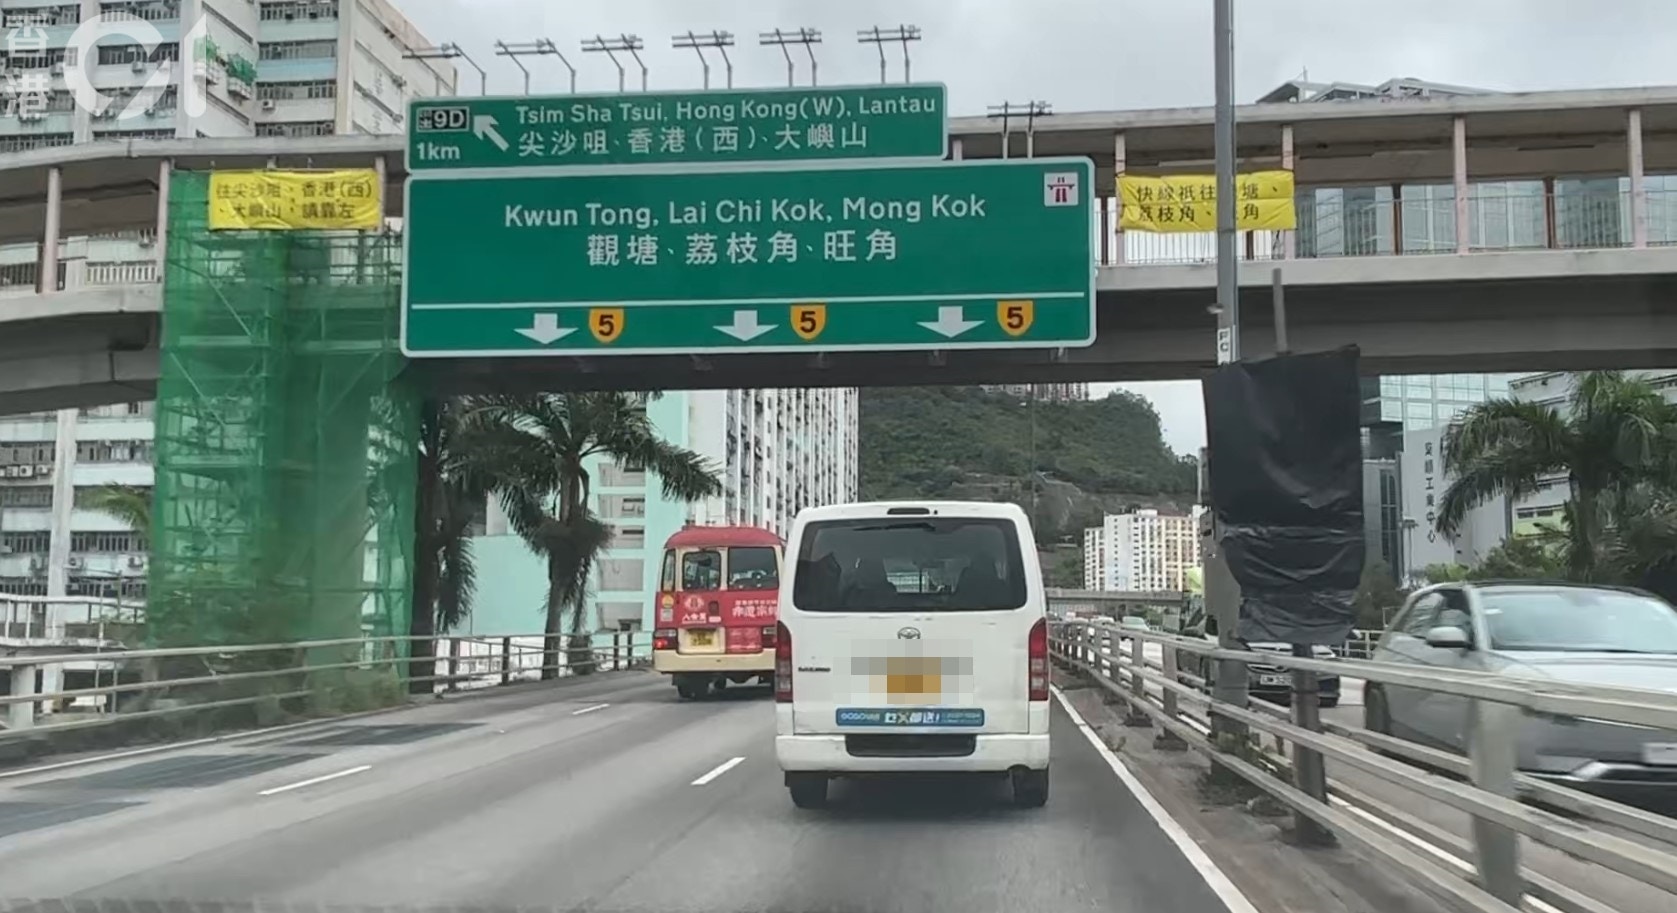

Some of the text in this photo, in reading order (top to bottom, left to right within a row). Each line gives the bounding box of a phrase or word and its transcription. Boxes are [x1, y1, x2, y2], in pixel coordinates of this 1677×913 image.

[433, 110, 465, 128] 9D
[515, 105, 565, 125] Tsim
[570, 104, 612, 123] Sha
[676, 101, 736, 123] Hong
[858, 94, 936, 115] Lantau
[416, 142, 461, 160] 1km
[505, 194, 986, 229] Kwun Tong, Lai Chi Kok, Mong Kok
[598, 313, 615, 337] 5
[799, 310, 817, 333] 5
[1006, 305, 1024, 329] 5
